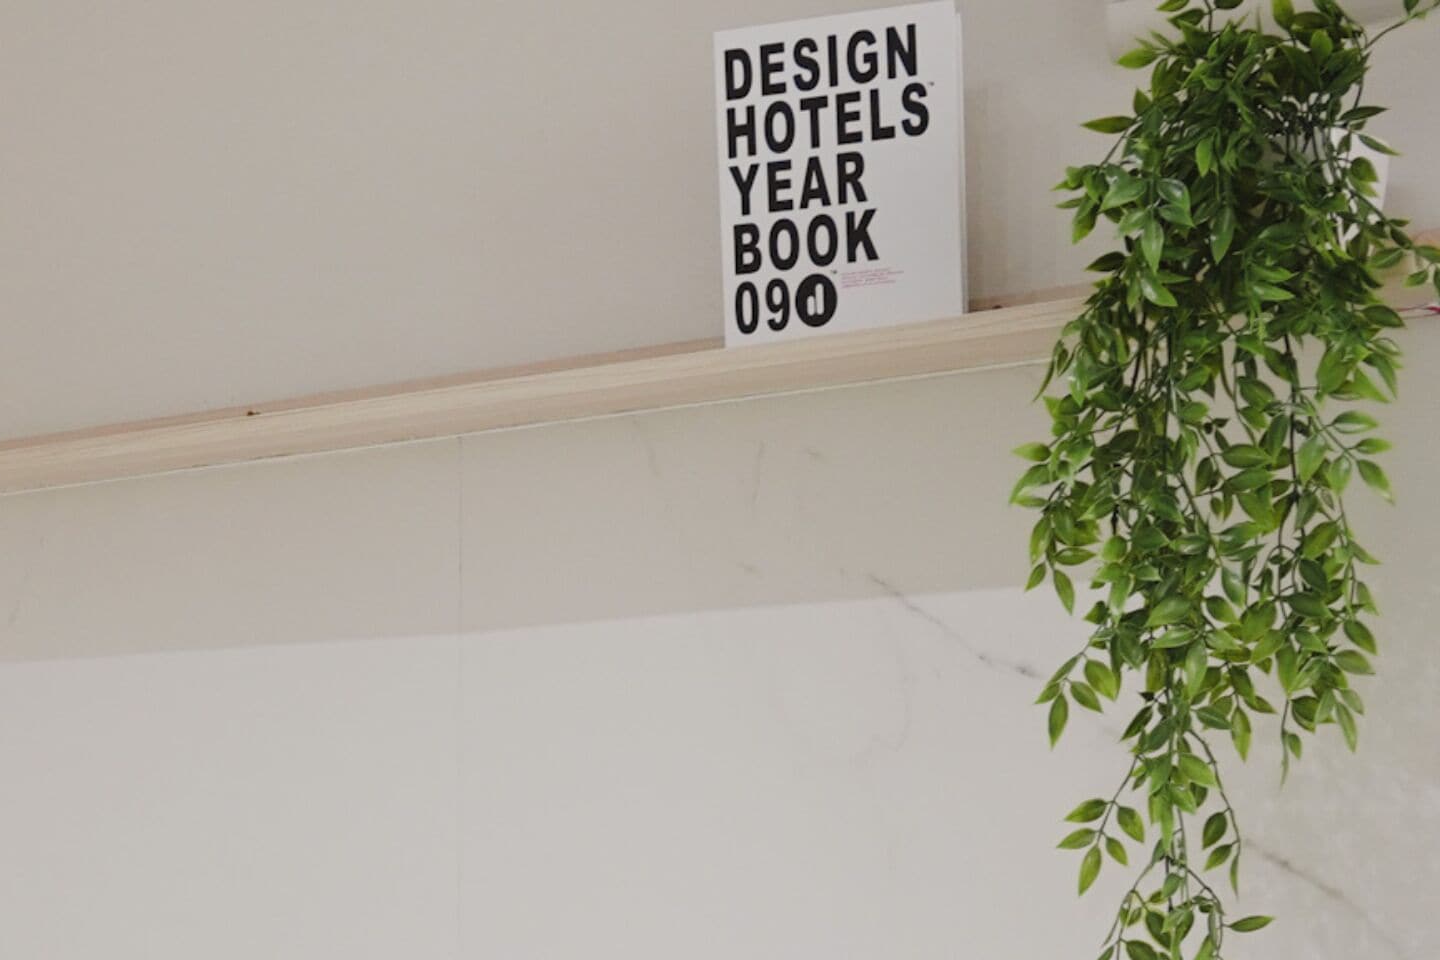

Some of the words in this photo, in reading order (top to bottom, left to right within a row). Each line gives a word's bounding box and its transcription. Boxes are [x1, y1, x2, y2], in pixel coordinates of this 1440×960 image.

[724, 23, 918, 102] DESIGN
[726, 82, 930, 160] HOTELS
[728, 151, 868, 217] YEAR
[733, 208, 880, 276] BOOK
